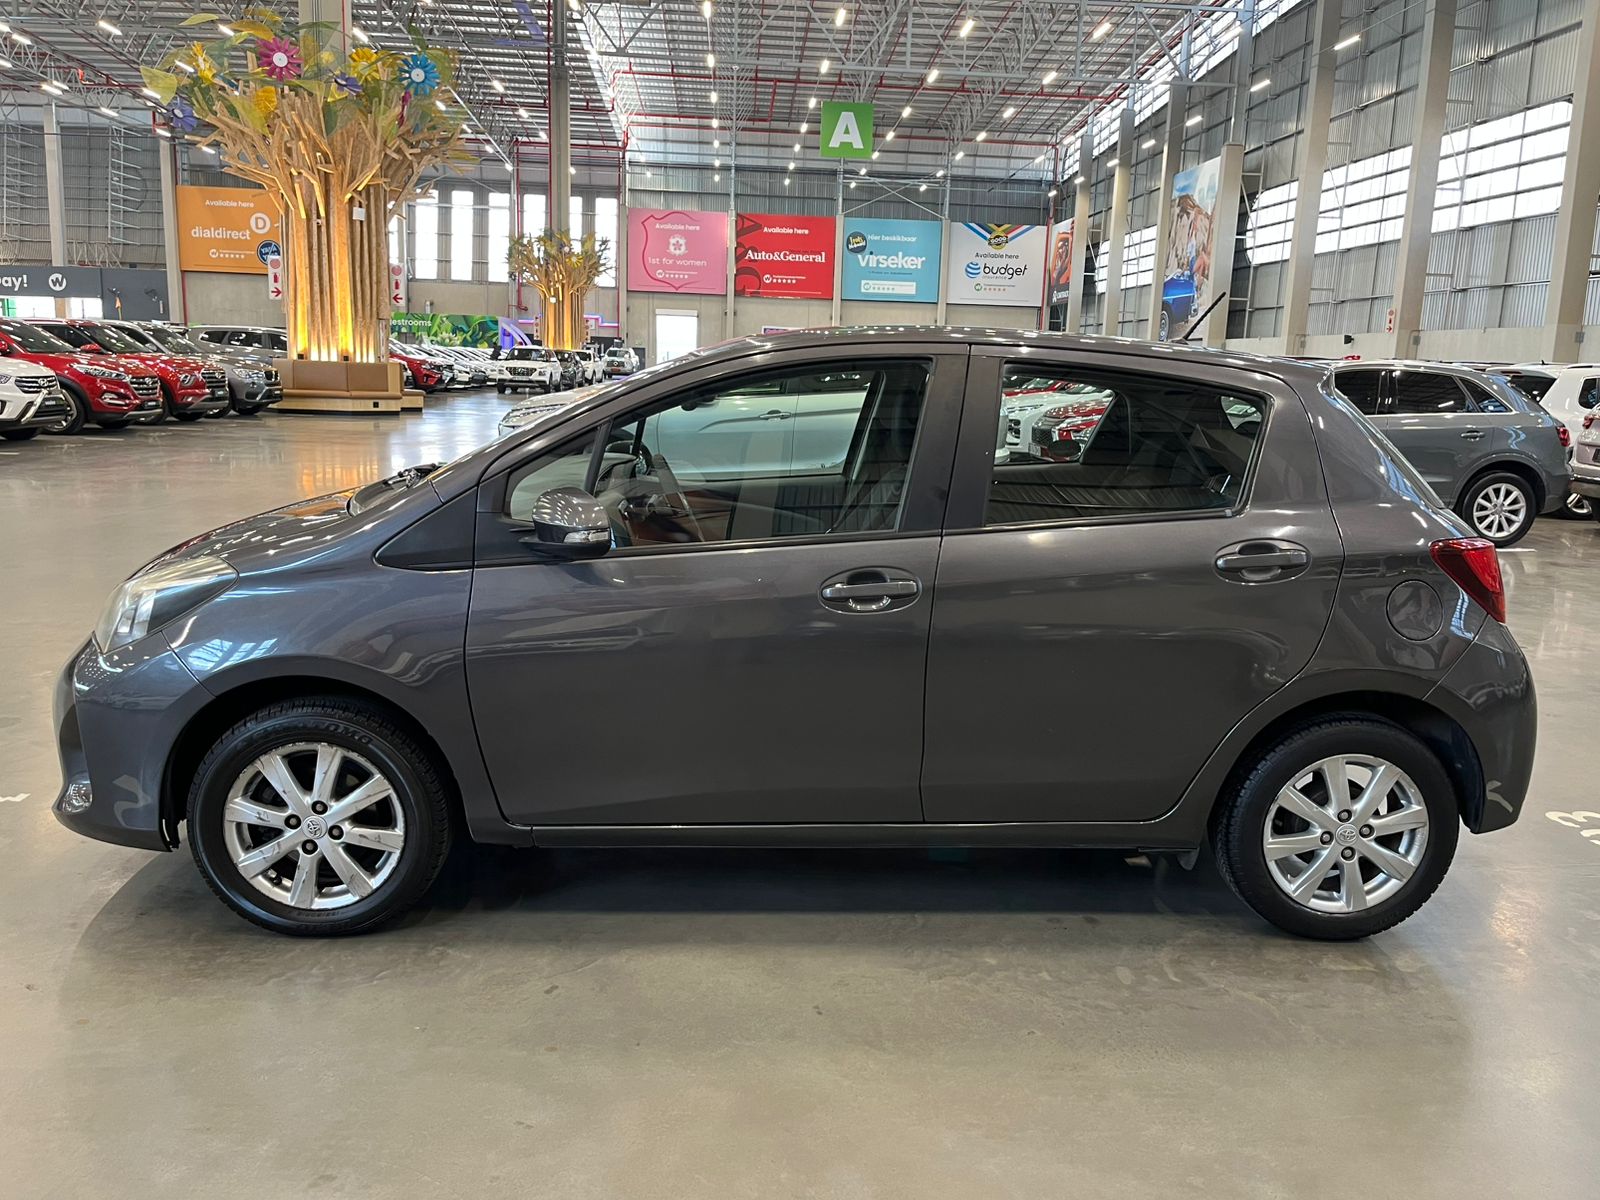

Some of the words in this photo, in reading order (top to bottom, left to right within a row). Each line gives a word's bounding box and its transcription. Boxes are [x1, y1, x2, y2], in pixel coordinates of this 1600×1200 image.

[828, 111, 864, 149] A
[205, 199, 238, 207] Available
[238, 200, 255, 208] here
[191, 226, 251, 240] dialdirect
[763, 226, 793, 234] Available
[793, 227, 809, 235] here
[648, 257, 661, 265] 1st
[662, 257, 674, 265] for
[675, 258, 707, 266] women
[745, 249, 826, 263] Auto&General
[857, 251, 926, 269] virseker
[982, 262, 1028, 280] budget
[0, 274, 28, 291] ay!
[390, 318, 432, 327] estrooms
